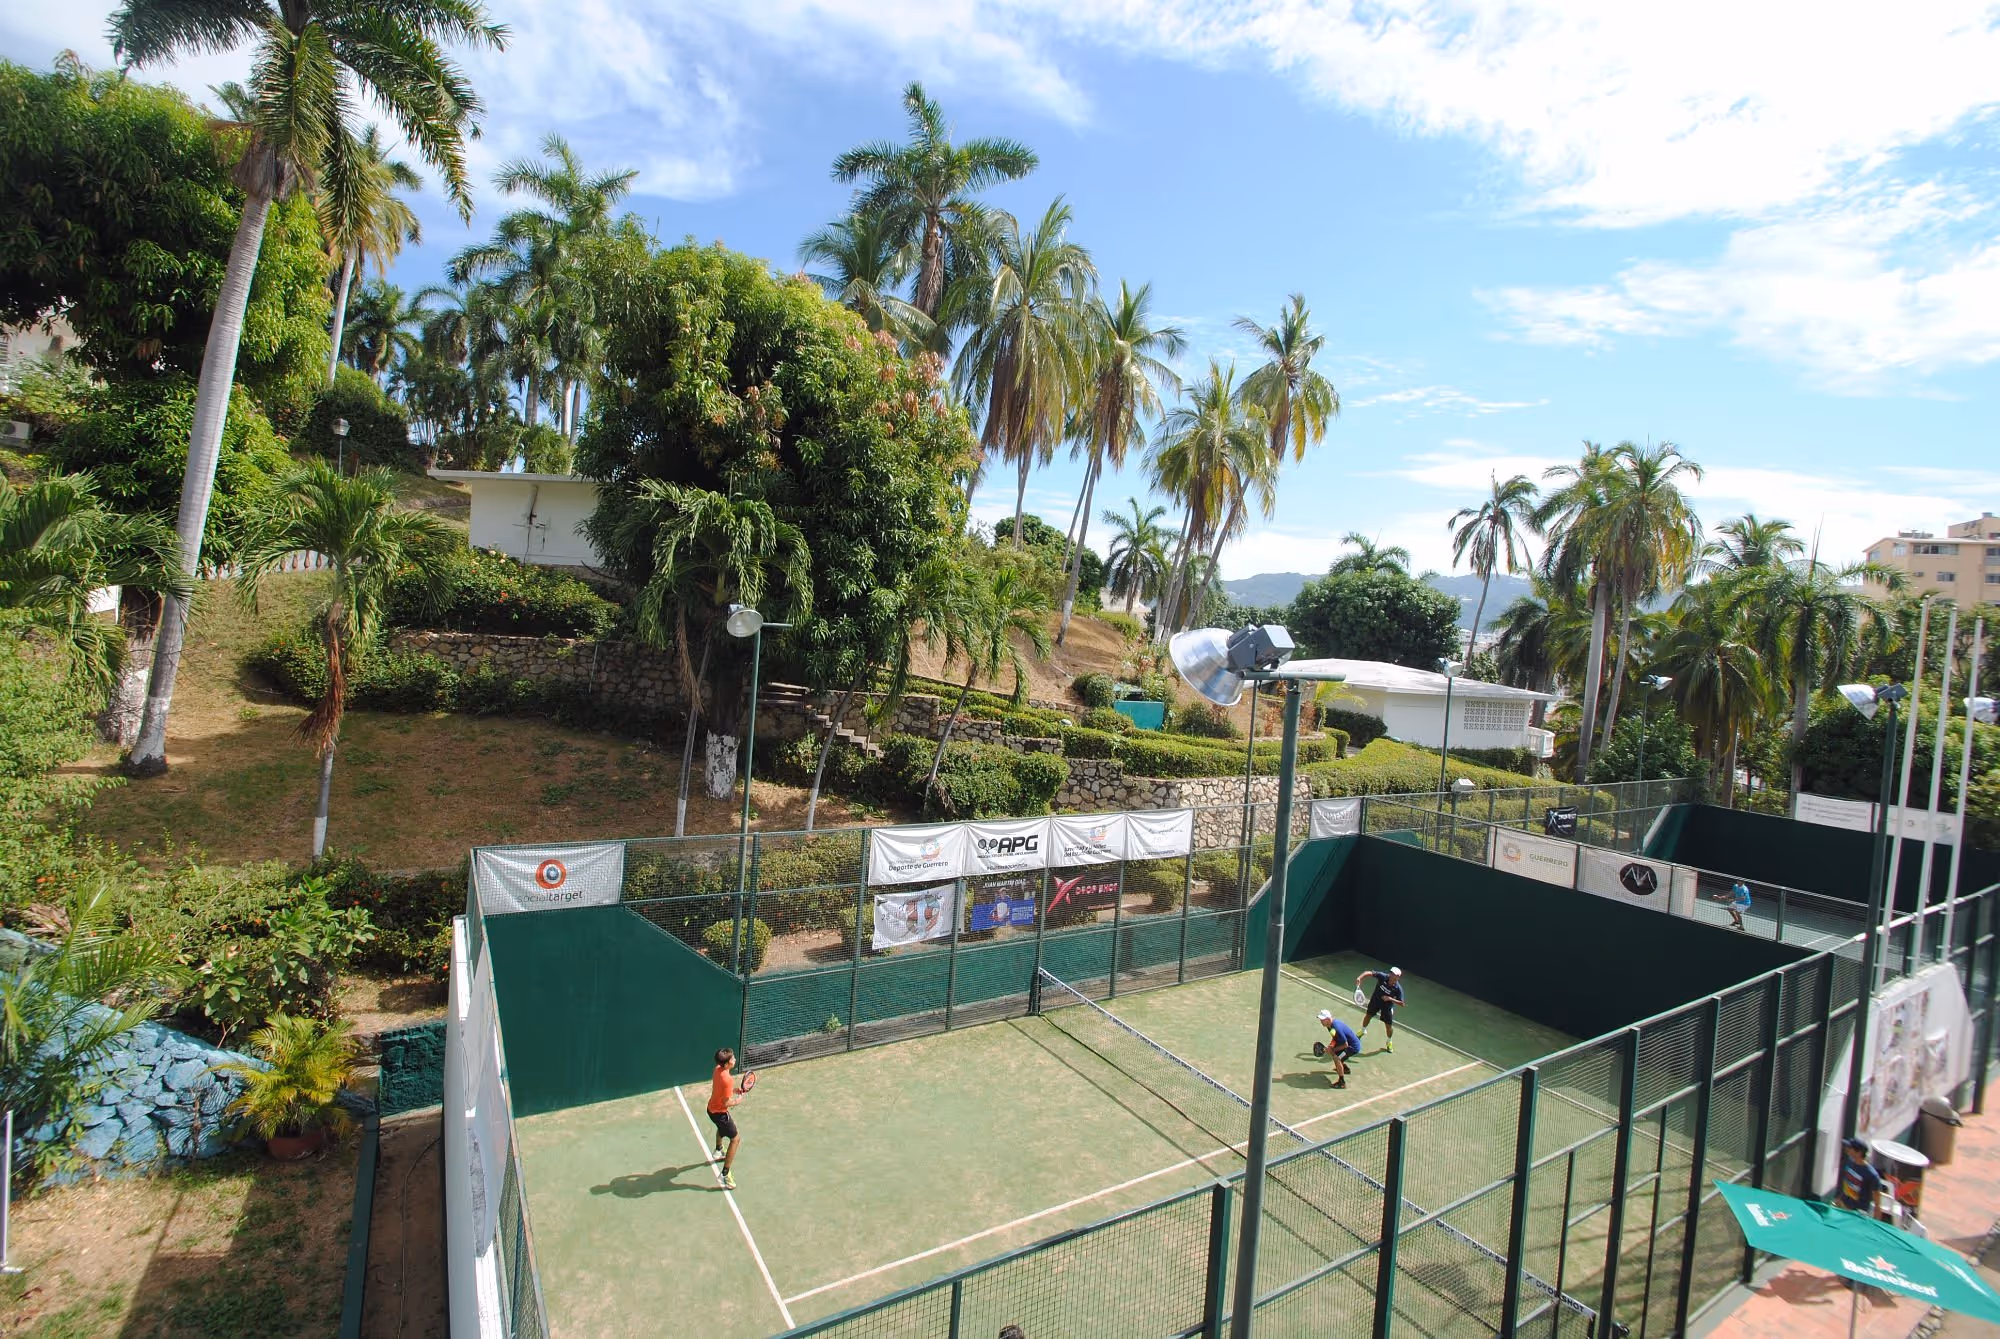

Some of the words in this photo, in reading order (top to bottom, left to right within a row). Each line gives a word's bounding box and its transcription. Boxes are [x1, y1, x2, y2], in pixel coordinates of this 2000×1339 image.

[997, 834, 1039, 853] APG
[888, 864, 914, 872] Deporte
[922, 861, 949, 869] Guerrero
[1529, 853, 1568, 868] GUERRERO
[1201, 1075, 1214, 1086] DROP
[1213, 1083, 1226, 1094] SHOT
[1236, 1097, 1250, 1108] DROP
[1274, 1122, 1289, 1133] DROP
[1289, 1130, 1304, 1143] SHOT
[1840, 1256, 1939, 1298] Heineken
[1560, 1295, 1585, 1313] SHOT
